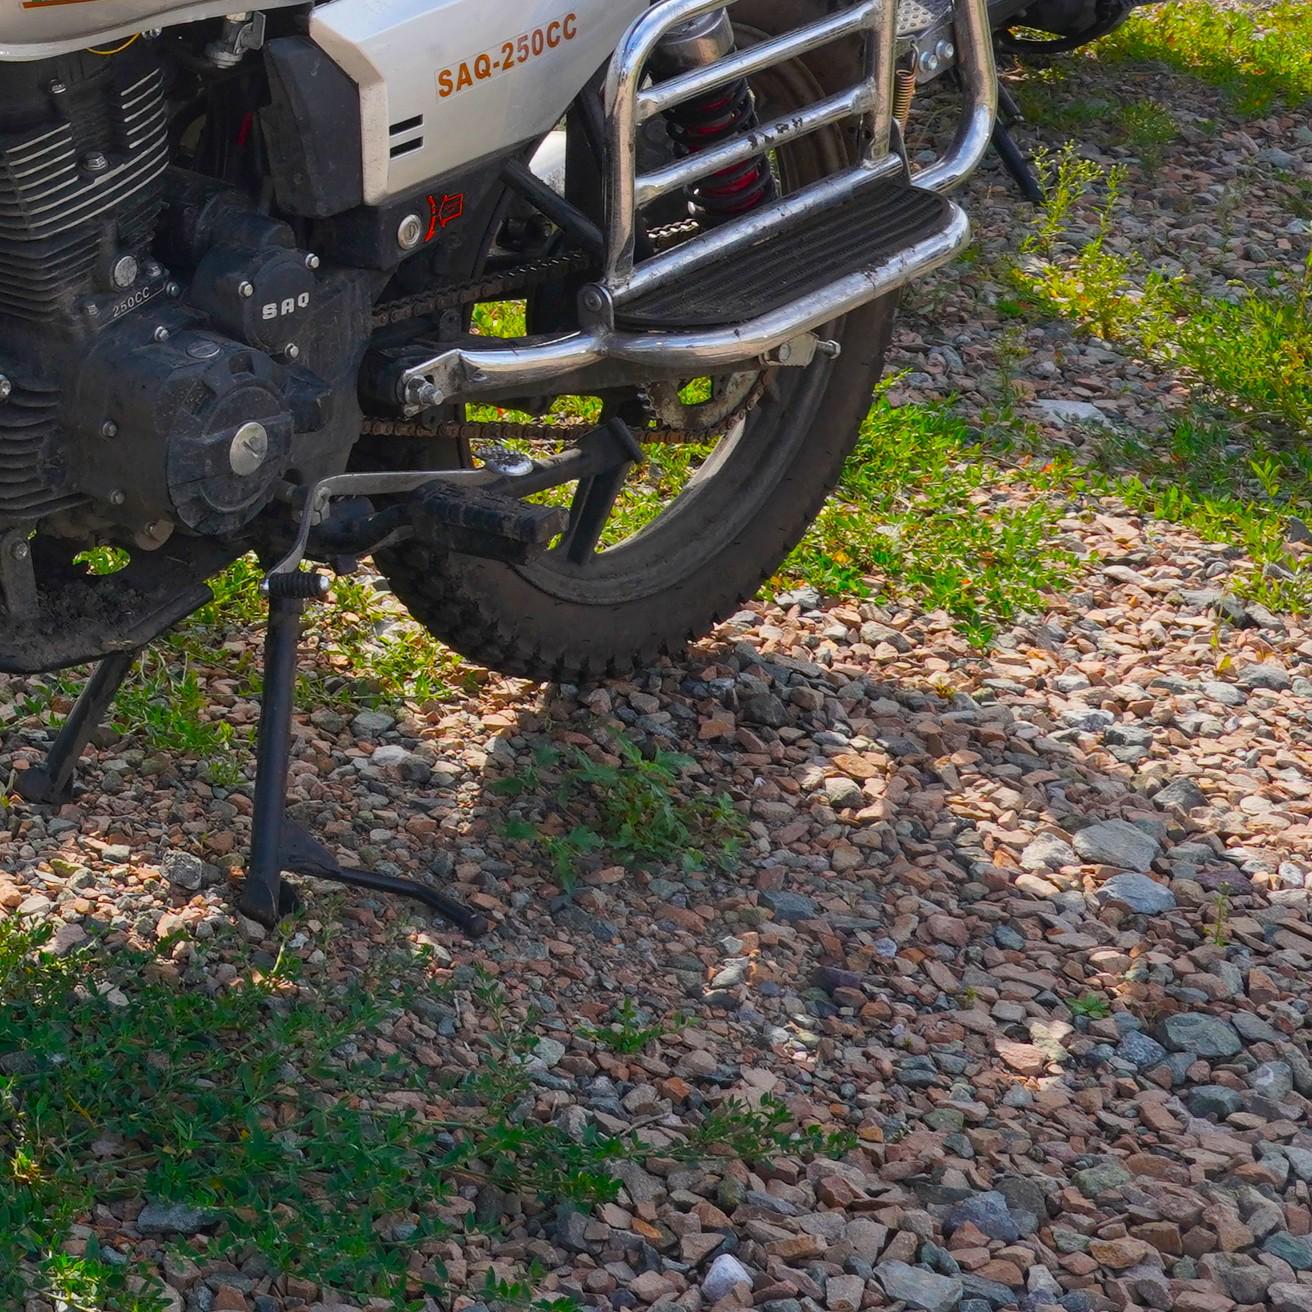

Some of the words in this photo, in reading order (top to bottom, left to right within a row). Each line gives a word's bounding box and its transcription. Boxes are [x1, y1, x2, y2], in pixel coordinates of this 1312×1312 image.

[438, 13, 577, 98] SAQ-250CC
[112, 287, 151, 318] 250CC
[262, 292, 310, 320] SAQ
